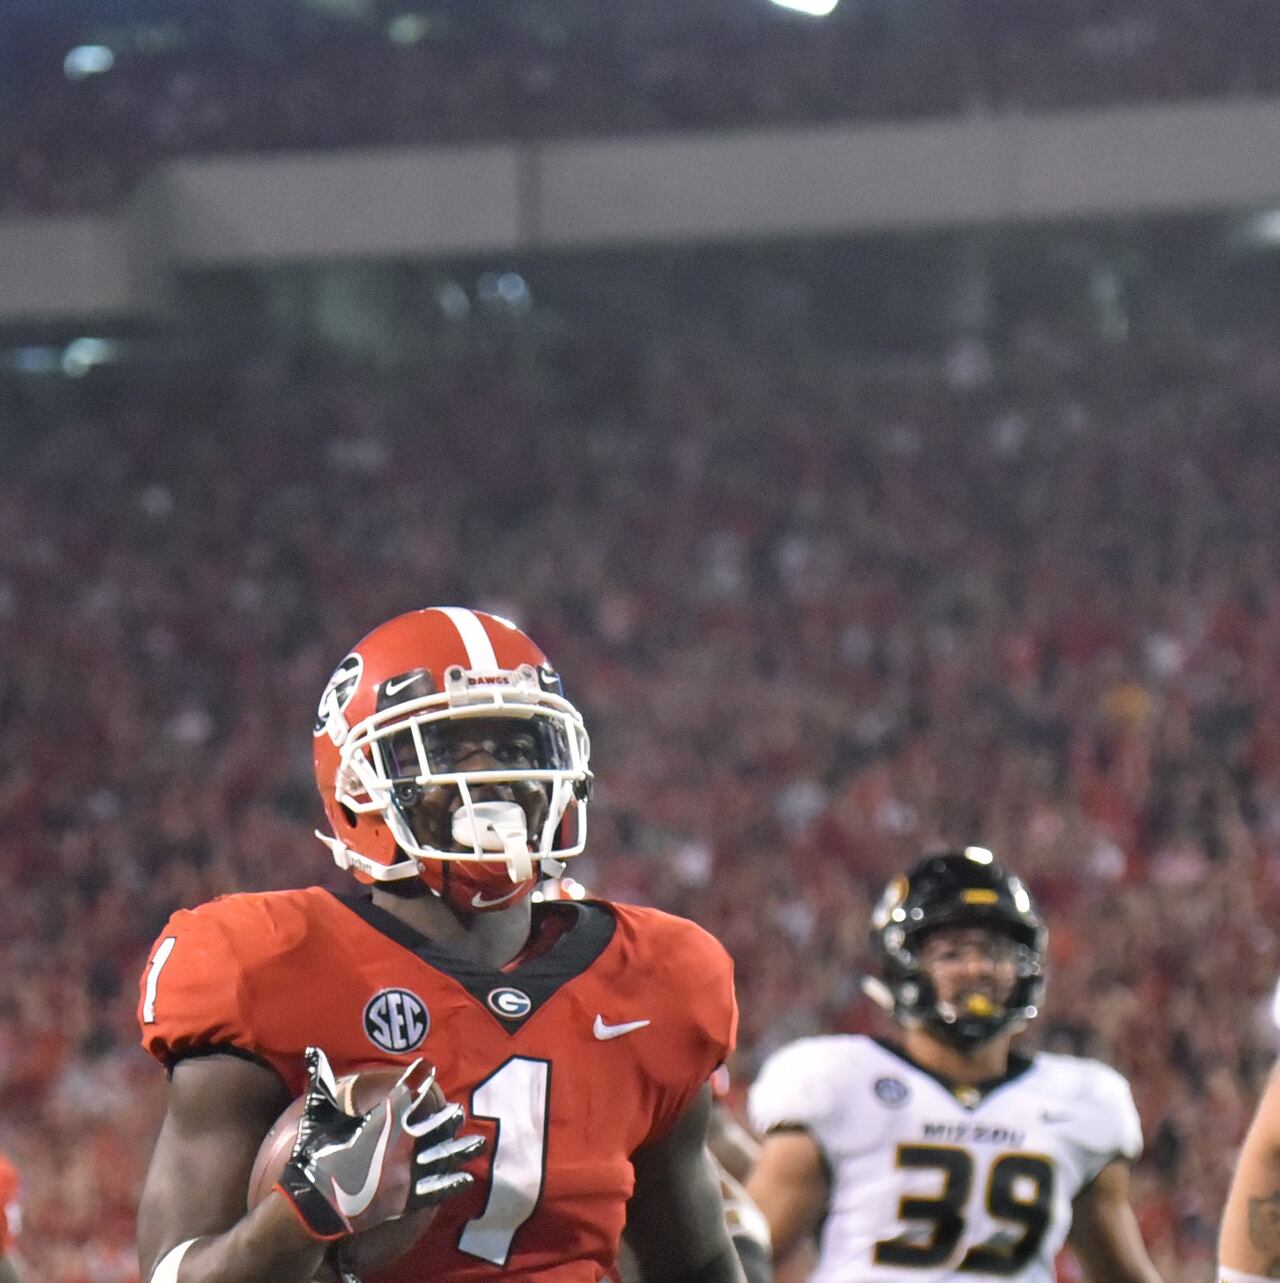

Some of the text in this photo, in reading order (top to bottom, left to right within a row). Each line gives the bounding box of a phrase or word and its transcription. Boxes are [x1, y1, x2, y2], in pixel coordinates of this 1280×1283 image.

[468, 677, 510, 685] DAWGS
[143, 936, 176, 1024] 1
[369, 993, 423, 1049] SEC
[457, 1055, 552, 1267] 1
[872, 1143, 1054, 1274] 39
